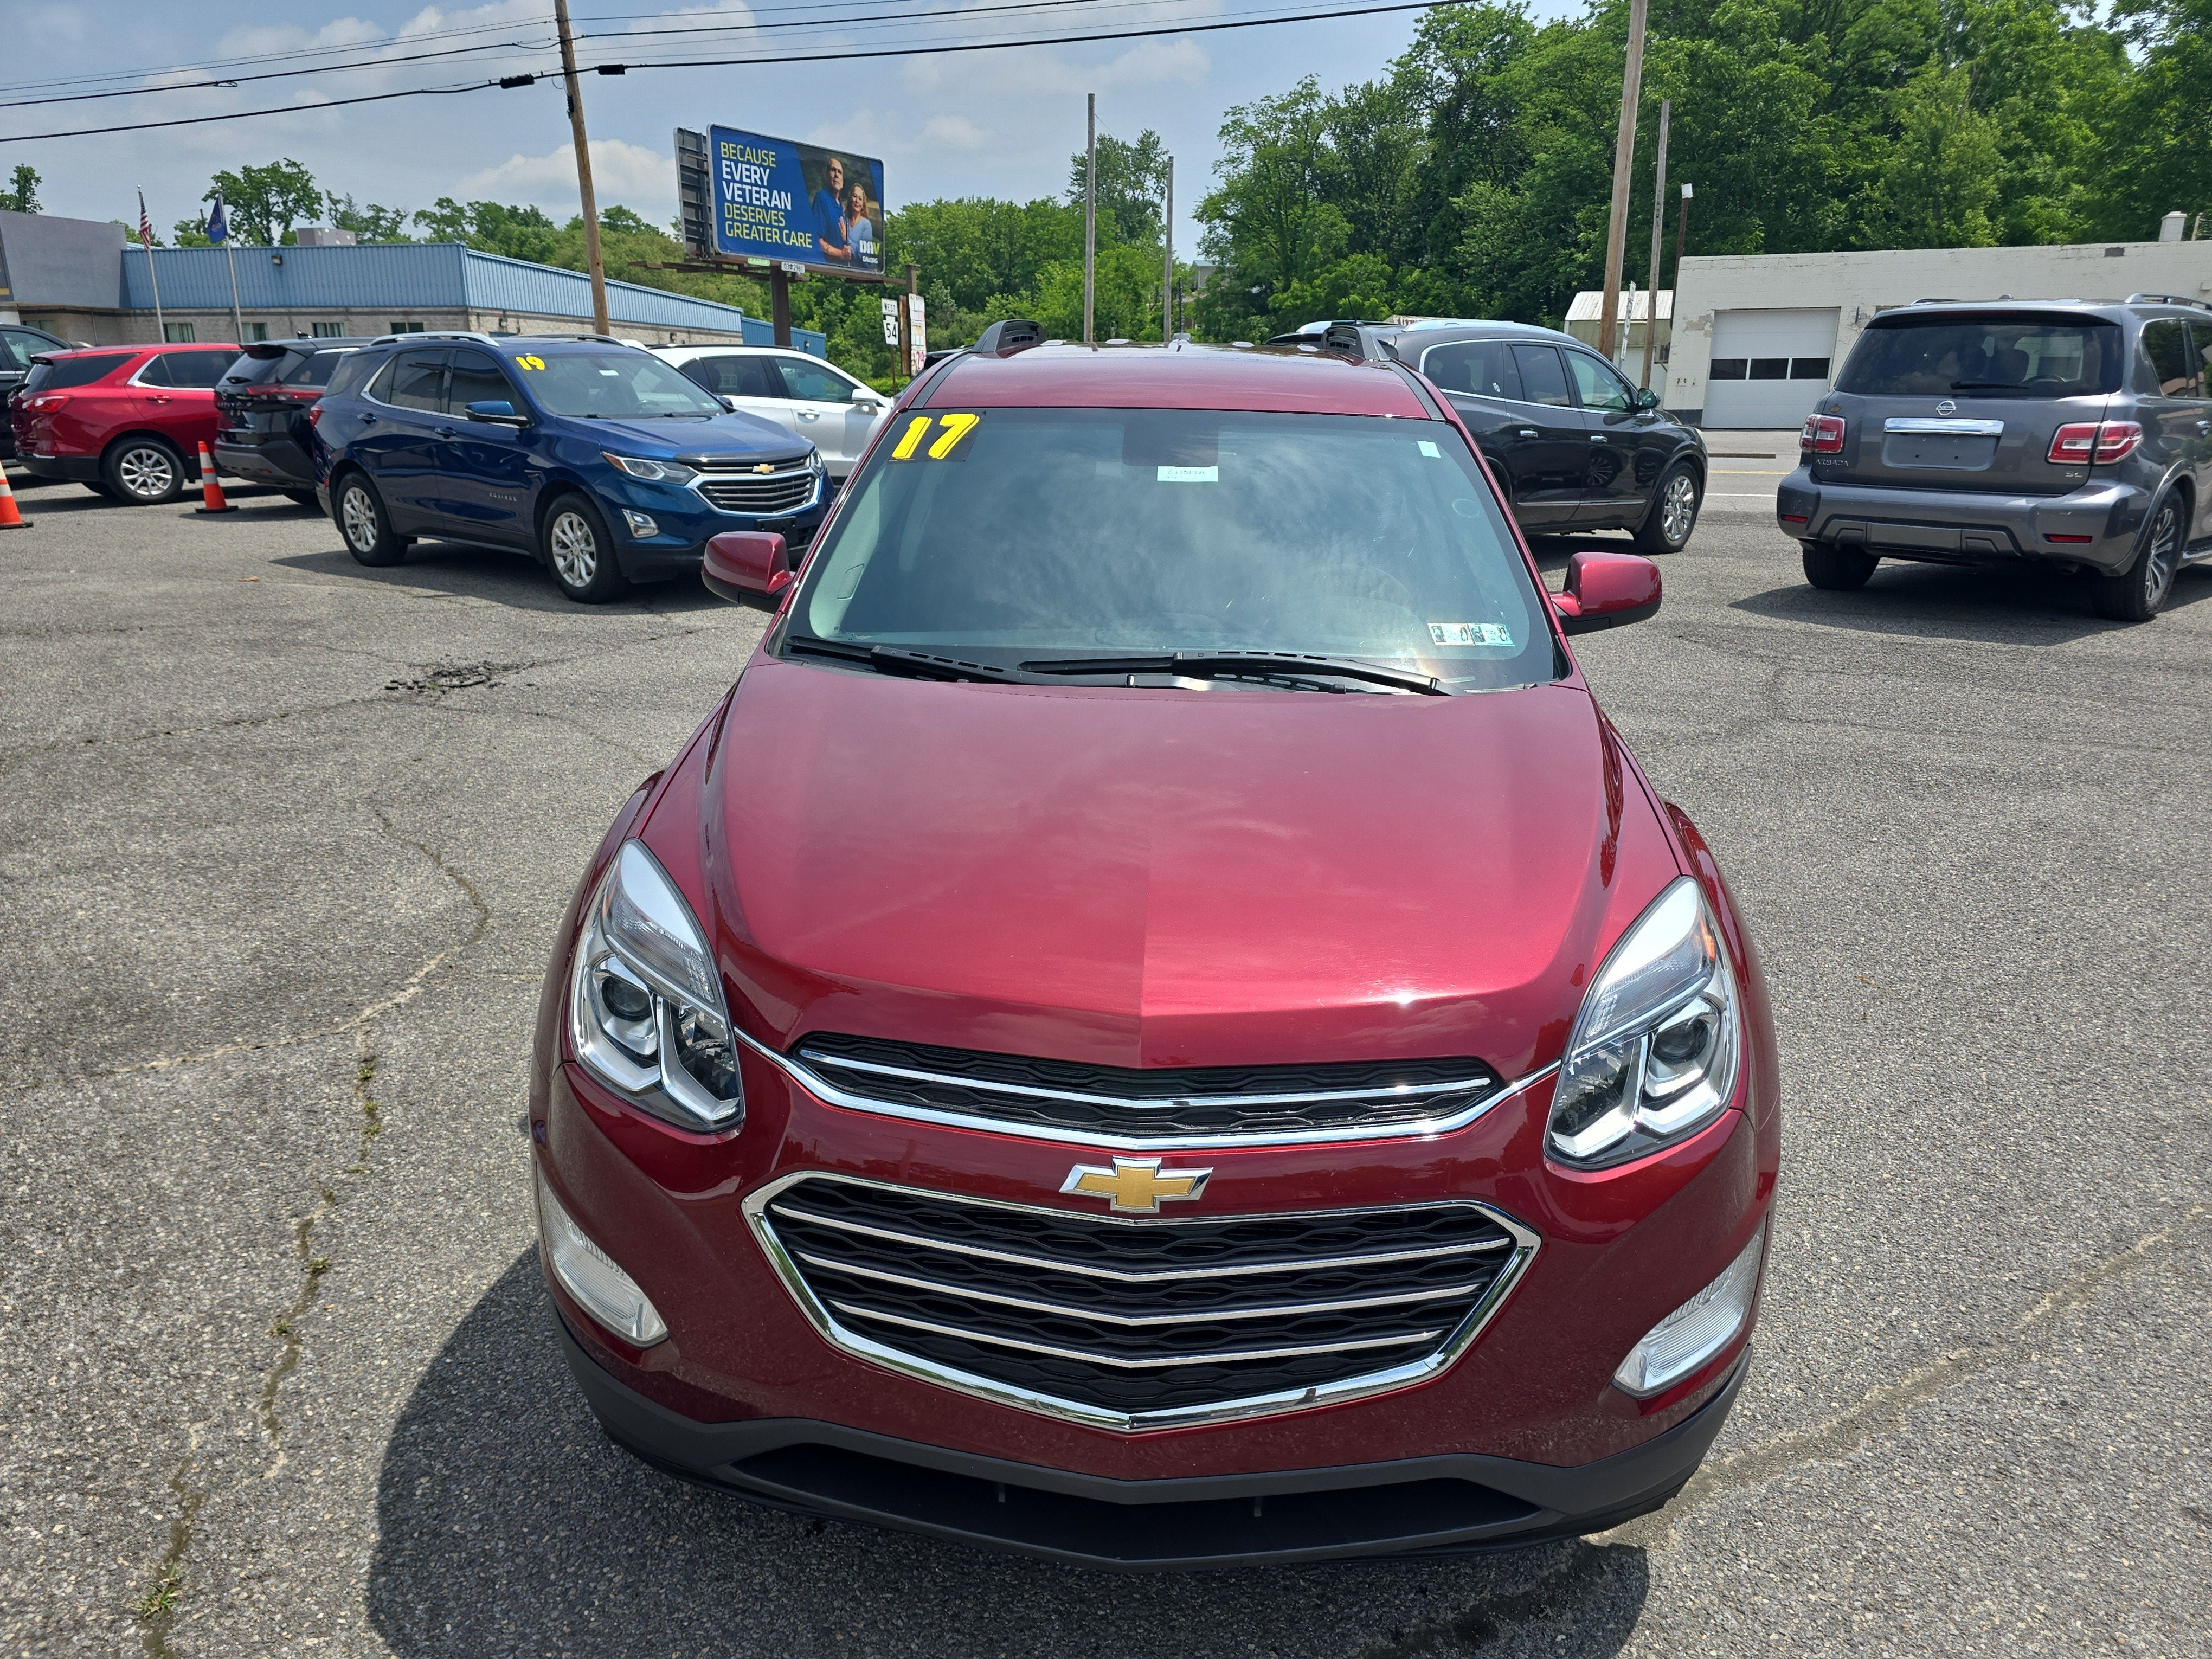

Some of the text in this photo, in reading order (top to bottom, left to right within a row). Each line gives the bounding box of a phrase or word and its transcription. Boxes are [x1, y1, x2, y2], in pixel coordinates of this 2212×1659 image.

[721, 142, 776, 167] BECAUSE
[722, 160, 769, 186] EVERY
[722, 181, 792, 210] VETERAN
[724, 202, 786, 227] DESERVES
[725, 221, 812, 248] GREATER CARE
[859, 240, 880, 255] DAV
[884, 302, 896, 313] WEST
[886, 323, 897, 339] 54
[516, 356, 545, 370] 19
[892, 414, 980, 459] 17
